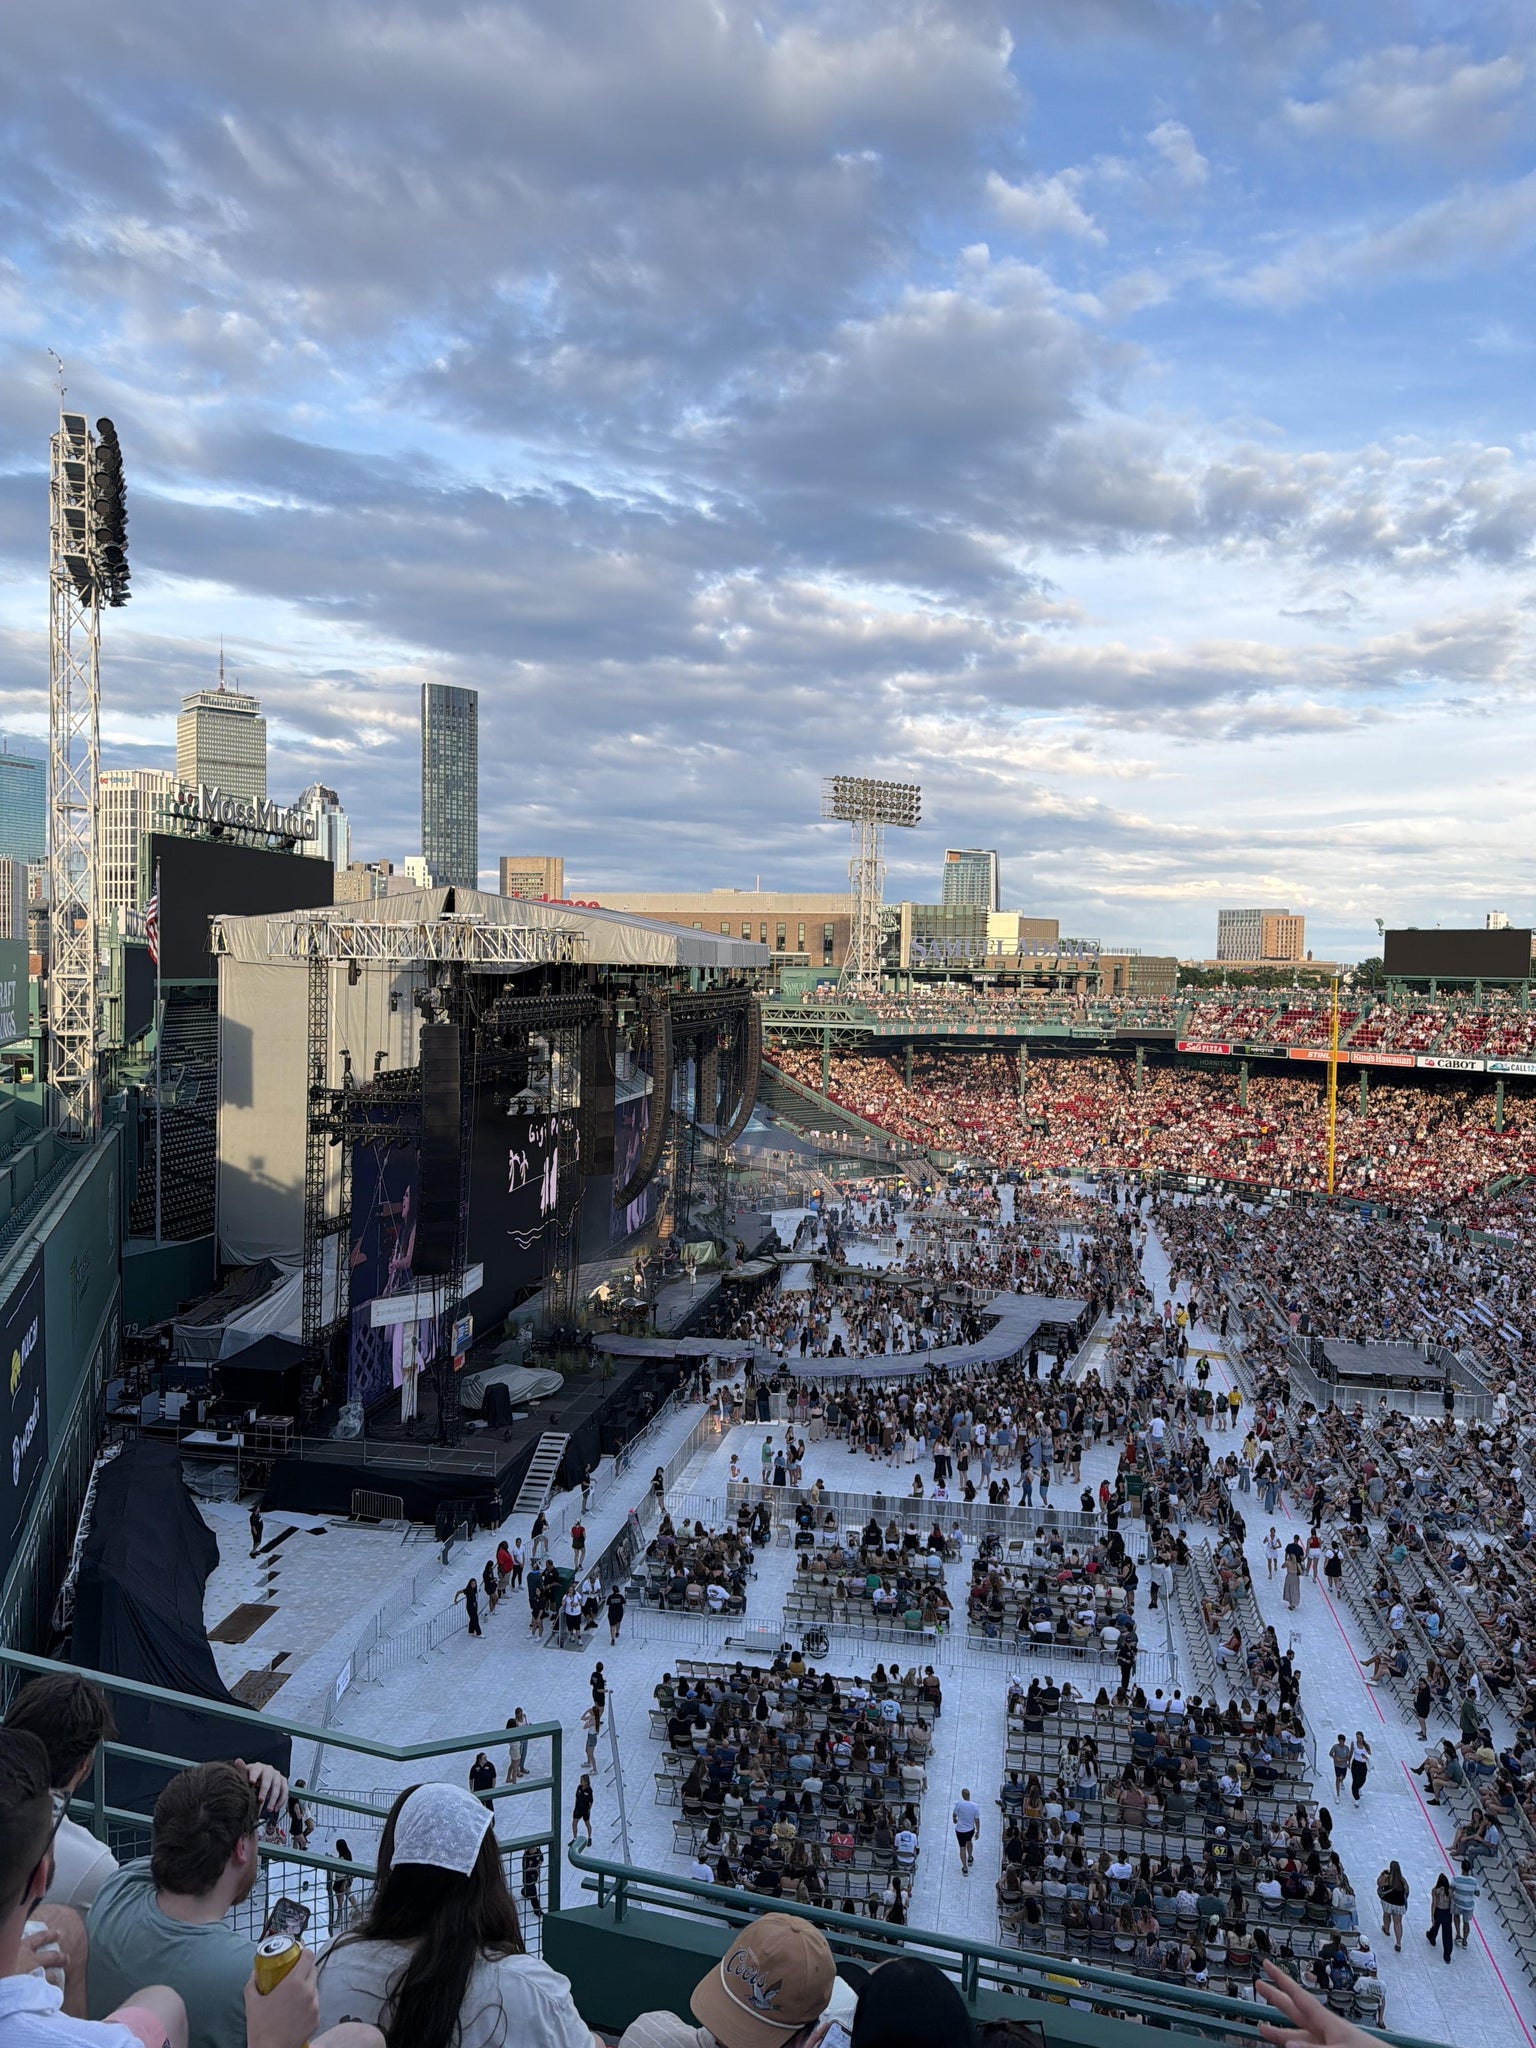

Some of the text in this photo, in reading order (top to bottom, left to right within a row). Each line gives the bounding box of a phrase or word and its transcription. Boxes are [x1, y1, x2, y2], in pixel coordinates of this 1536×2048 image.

[198, 783, 319, 841] MassMutual
[910, 936, 1100, 961] SAMUEL ADAMS
[1202, 1045, 1223, 1053] PIZZA
[1307, 1050, 1331, 1059] STIHL
[1375, 1054, 1412, 1065] Hawaiian
[1511, 1063, 1527, 1071] CALL
[726, 1948, 767, 1988] Coors
